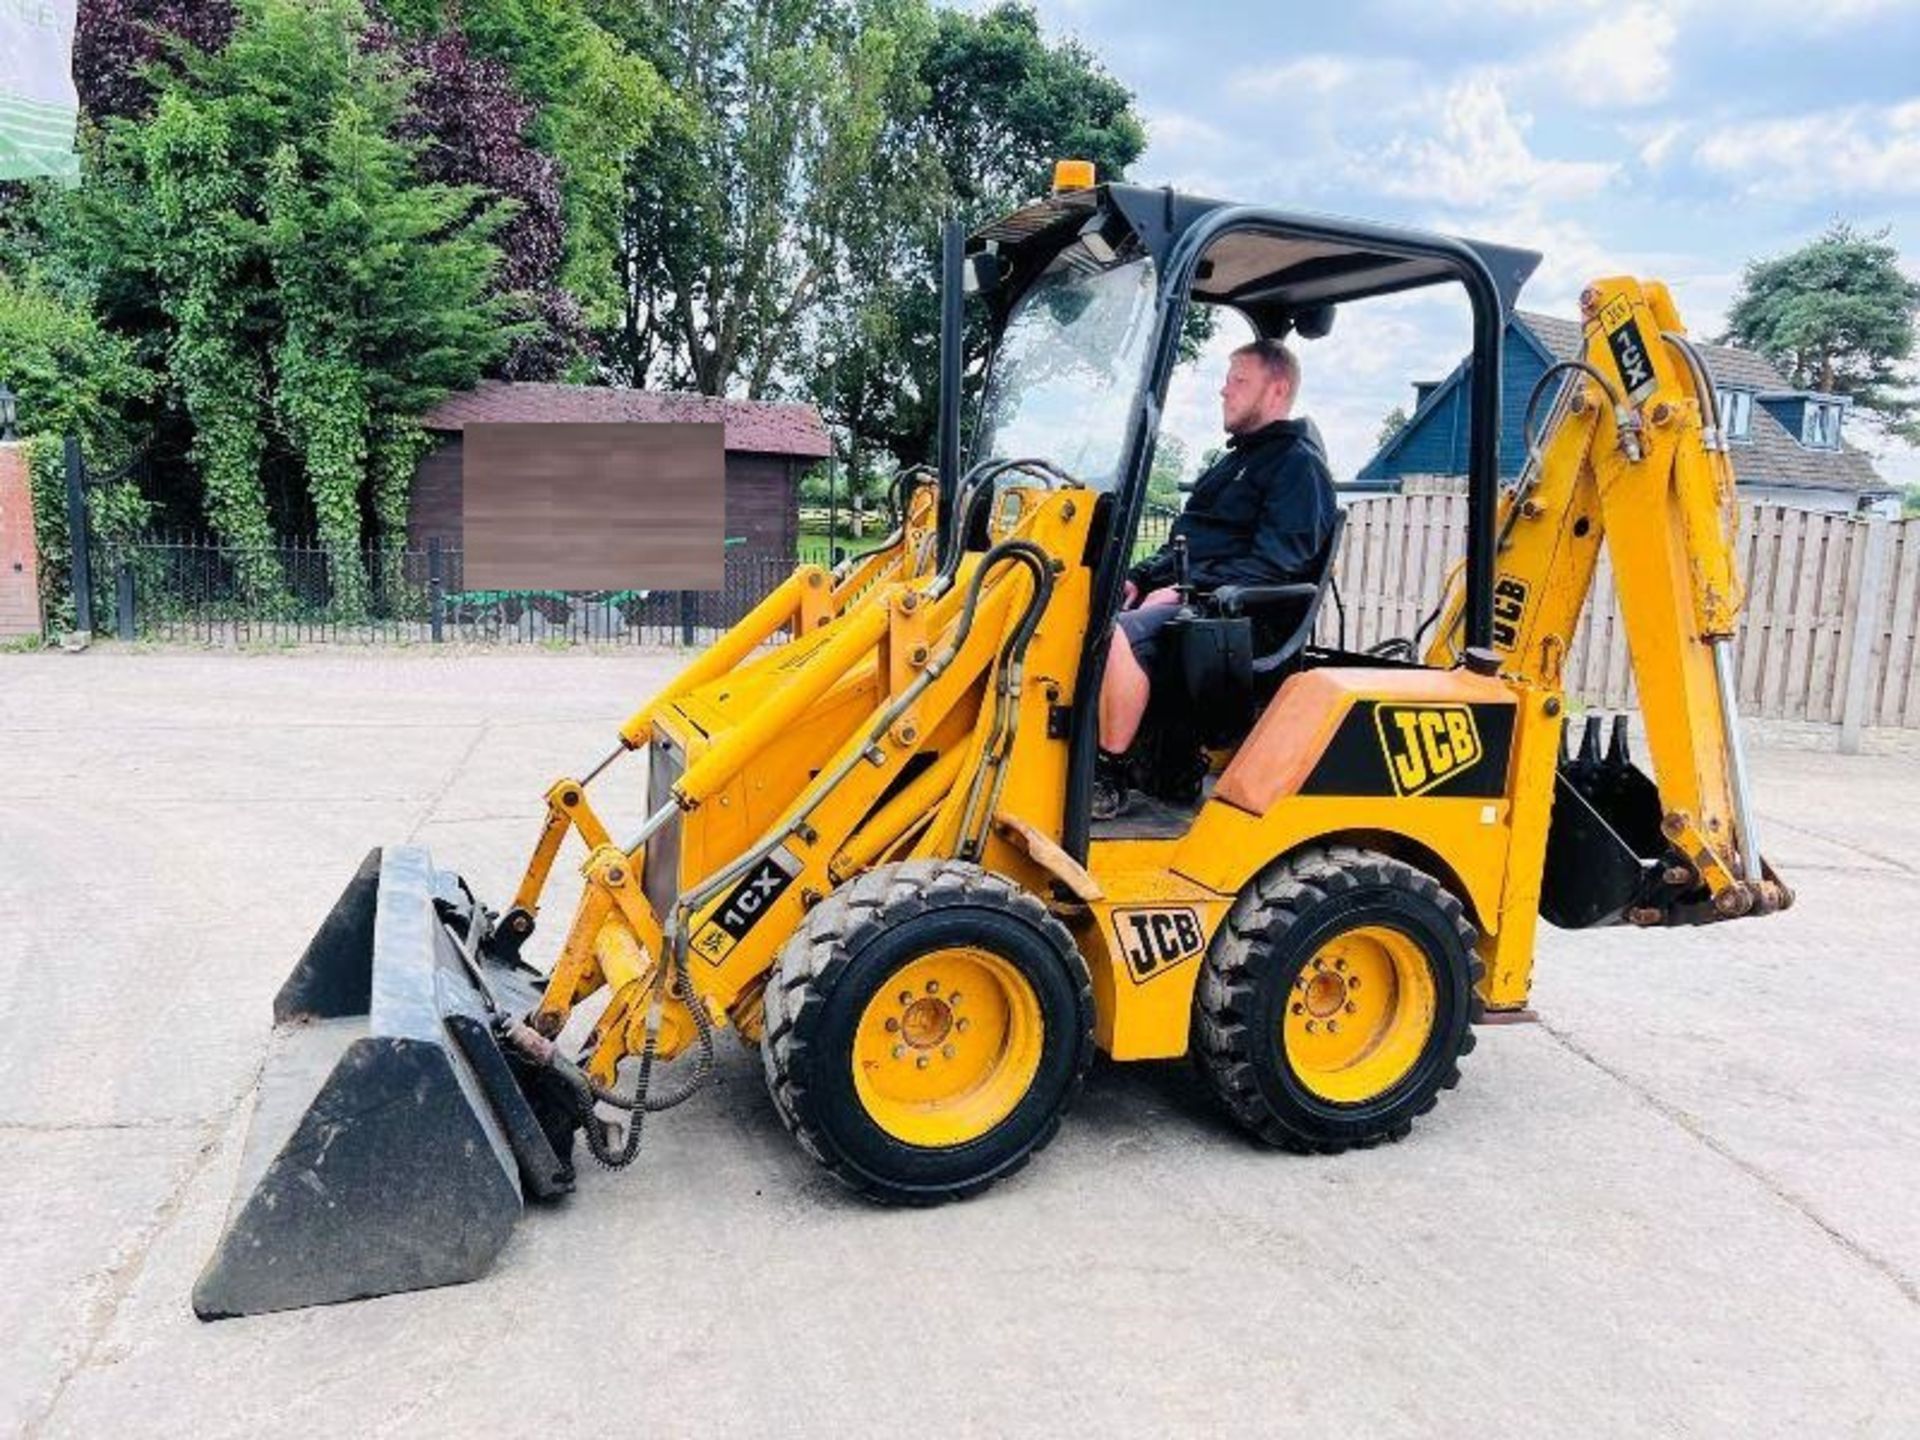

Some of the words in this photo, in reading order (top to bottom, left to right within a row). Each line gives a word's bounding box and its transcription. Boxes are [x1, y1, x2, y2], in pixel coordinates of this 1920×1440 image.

[1616, 330, 1648, 387] 1CX
[1394, 711, 1474, 789] JCB
[724, 866, 782, 926] 1CX
[1129, 914, 1199, 974] JCB
